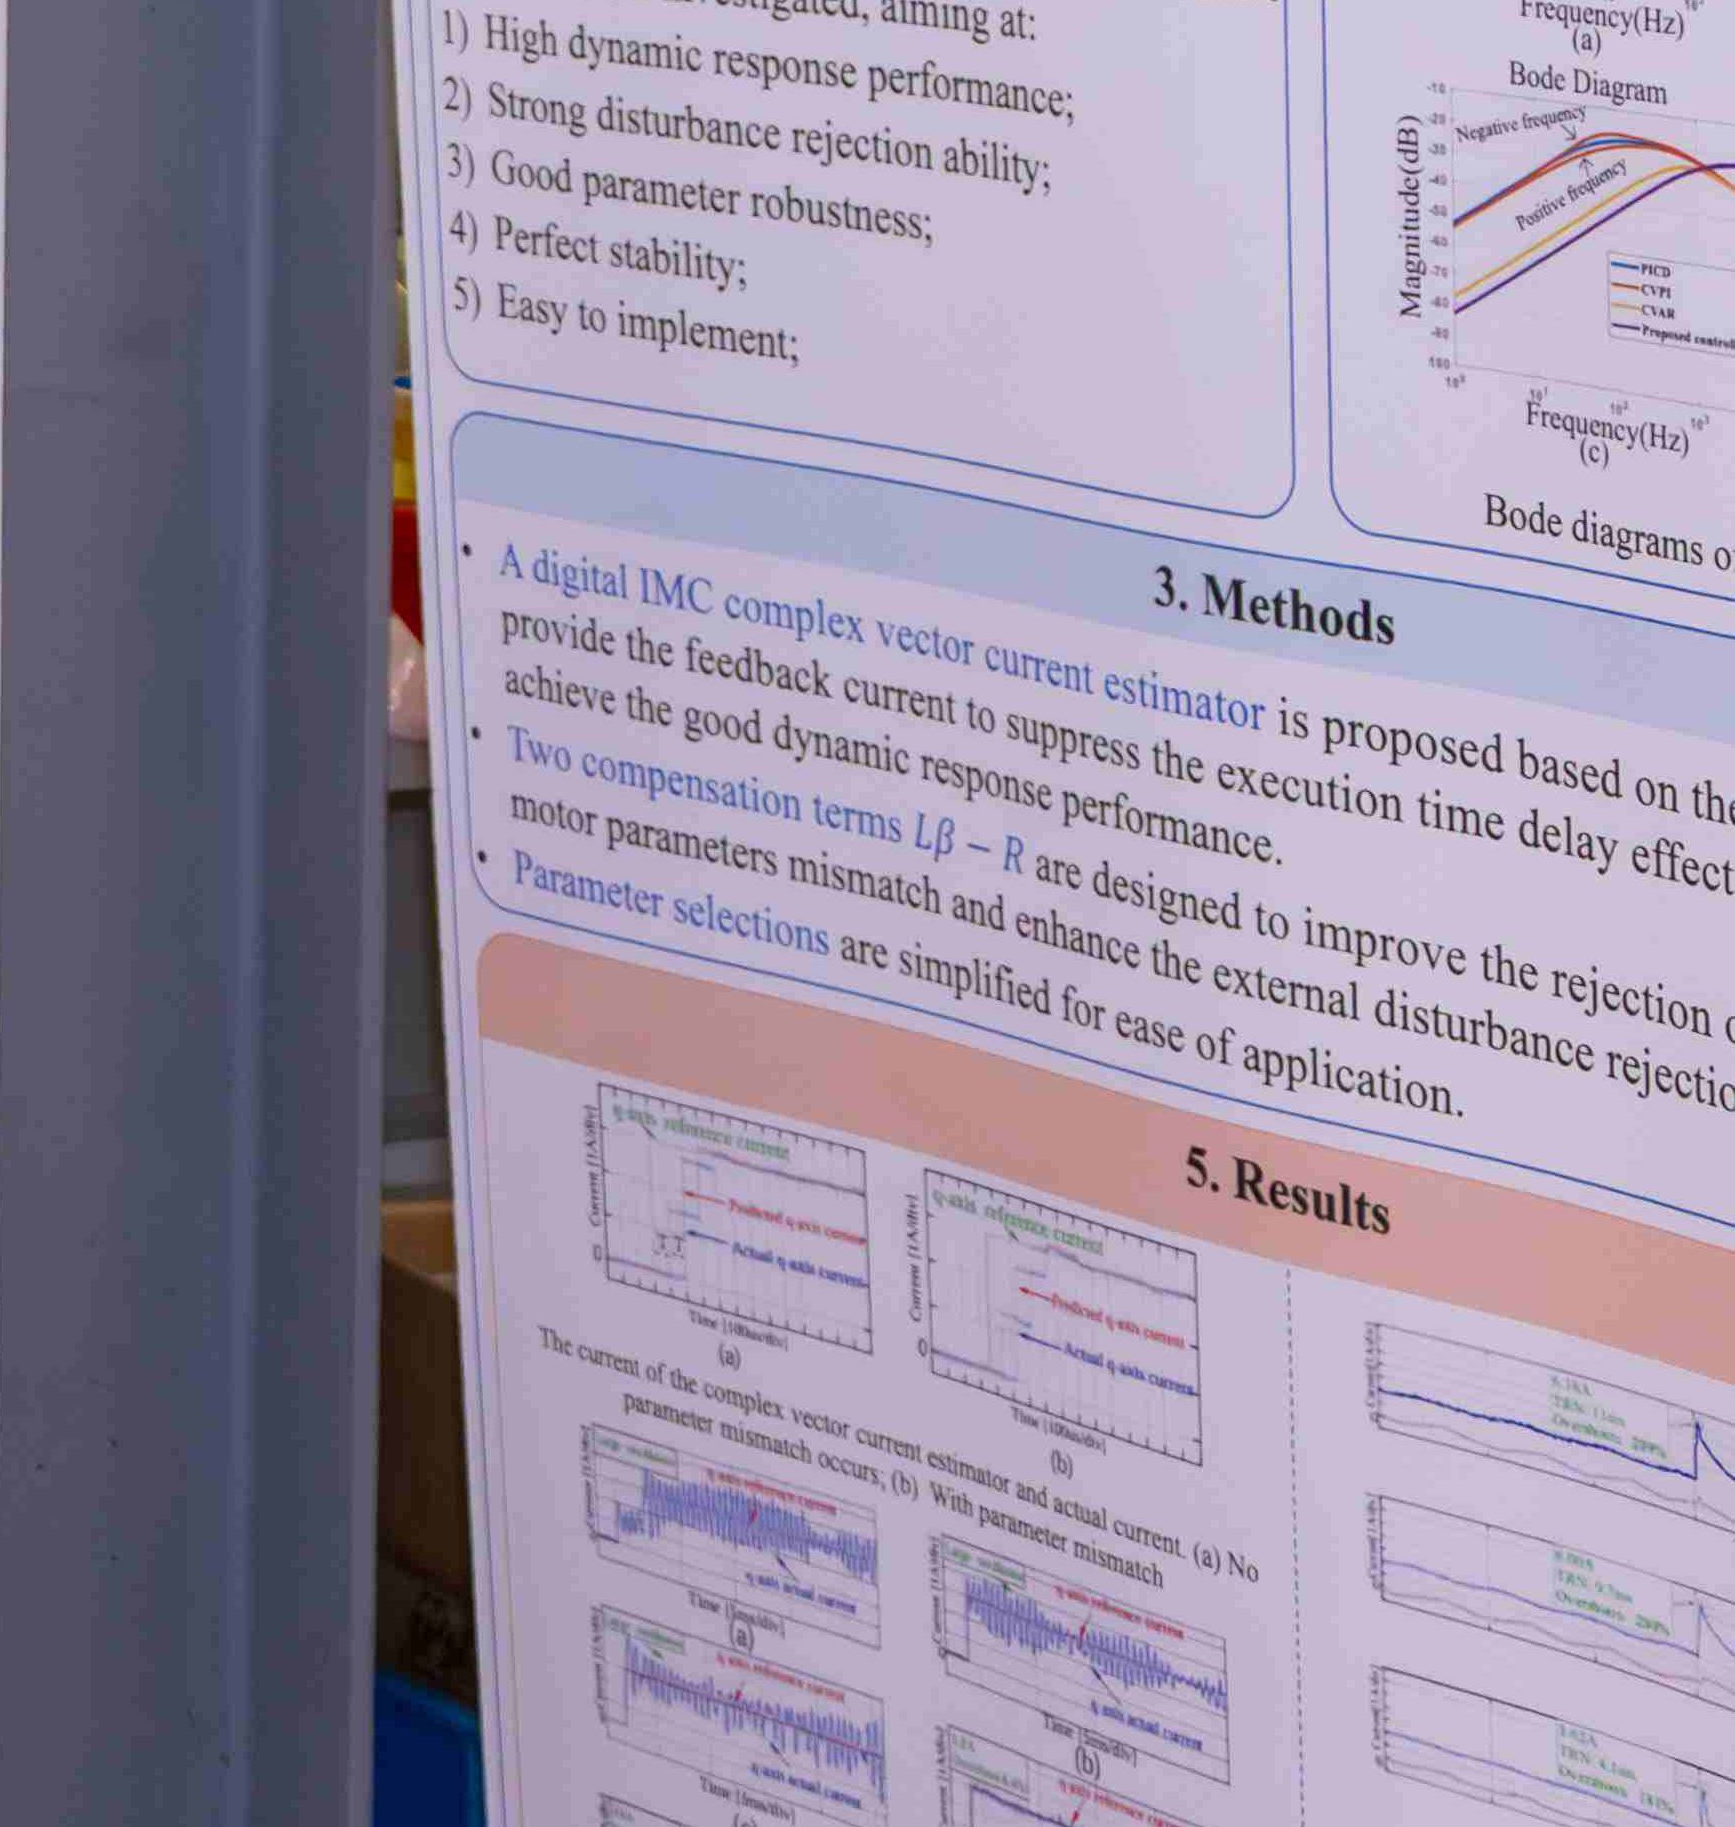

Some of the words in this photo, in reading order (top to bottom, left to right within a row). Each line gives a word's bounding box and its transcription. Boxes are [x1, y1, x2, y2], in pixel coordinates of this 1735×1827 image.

[444, 76, 471, 118] 2)
[489, 82, 587, 138] Strong
[597, 95, 780, 150] disturbance
[792, 120, 933, 170] rejection
[943, 137, 1050, 196] ability;
[454, 276, 481, 319] 5)
[498, 282, 567, 335] Easy
[578, 301, 606, 333] to
[618, 300, 798, 367] implement;
[1154, 565, 1188, 611] 3.
[1202, 573, 1394, 645] Methods
[515, 850, 663, 917] Parameter
[674, 894, 829, 955] selections
[841, 936, 888, 969] are
[899, 942, 1051, 1015] simplified
[1062, 985, 1106, 1031] for
[1115, 1012, 1184, 1053] ease
[1196, 1027, 1236, 1065] of
[1243, 1045, 1463, 1118] application.
[1187, 1145, 1219, 1193] 5.
[1232, 1156, 1390, 1235] Results
[623, 1393, 714, 1434] parameter
[720, 1422, 812, 1464] mismatch
[818, 1452, 885, 1491] occurs;
[891, 1470, 919, 1501] (b)
[929, 1482, 973, 1517] With
[979, 1505, 1068, 1552] parameter
[1073, 1541, 1163, 1589] mismatch
